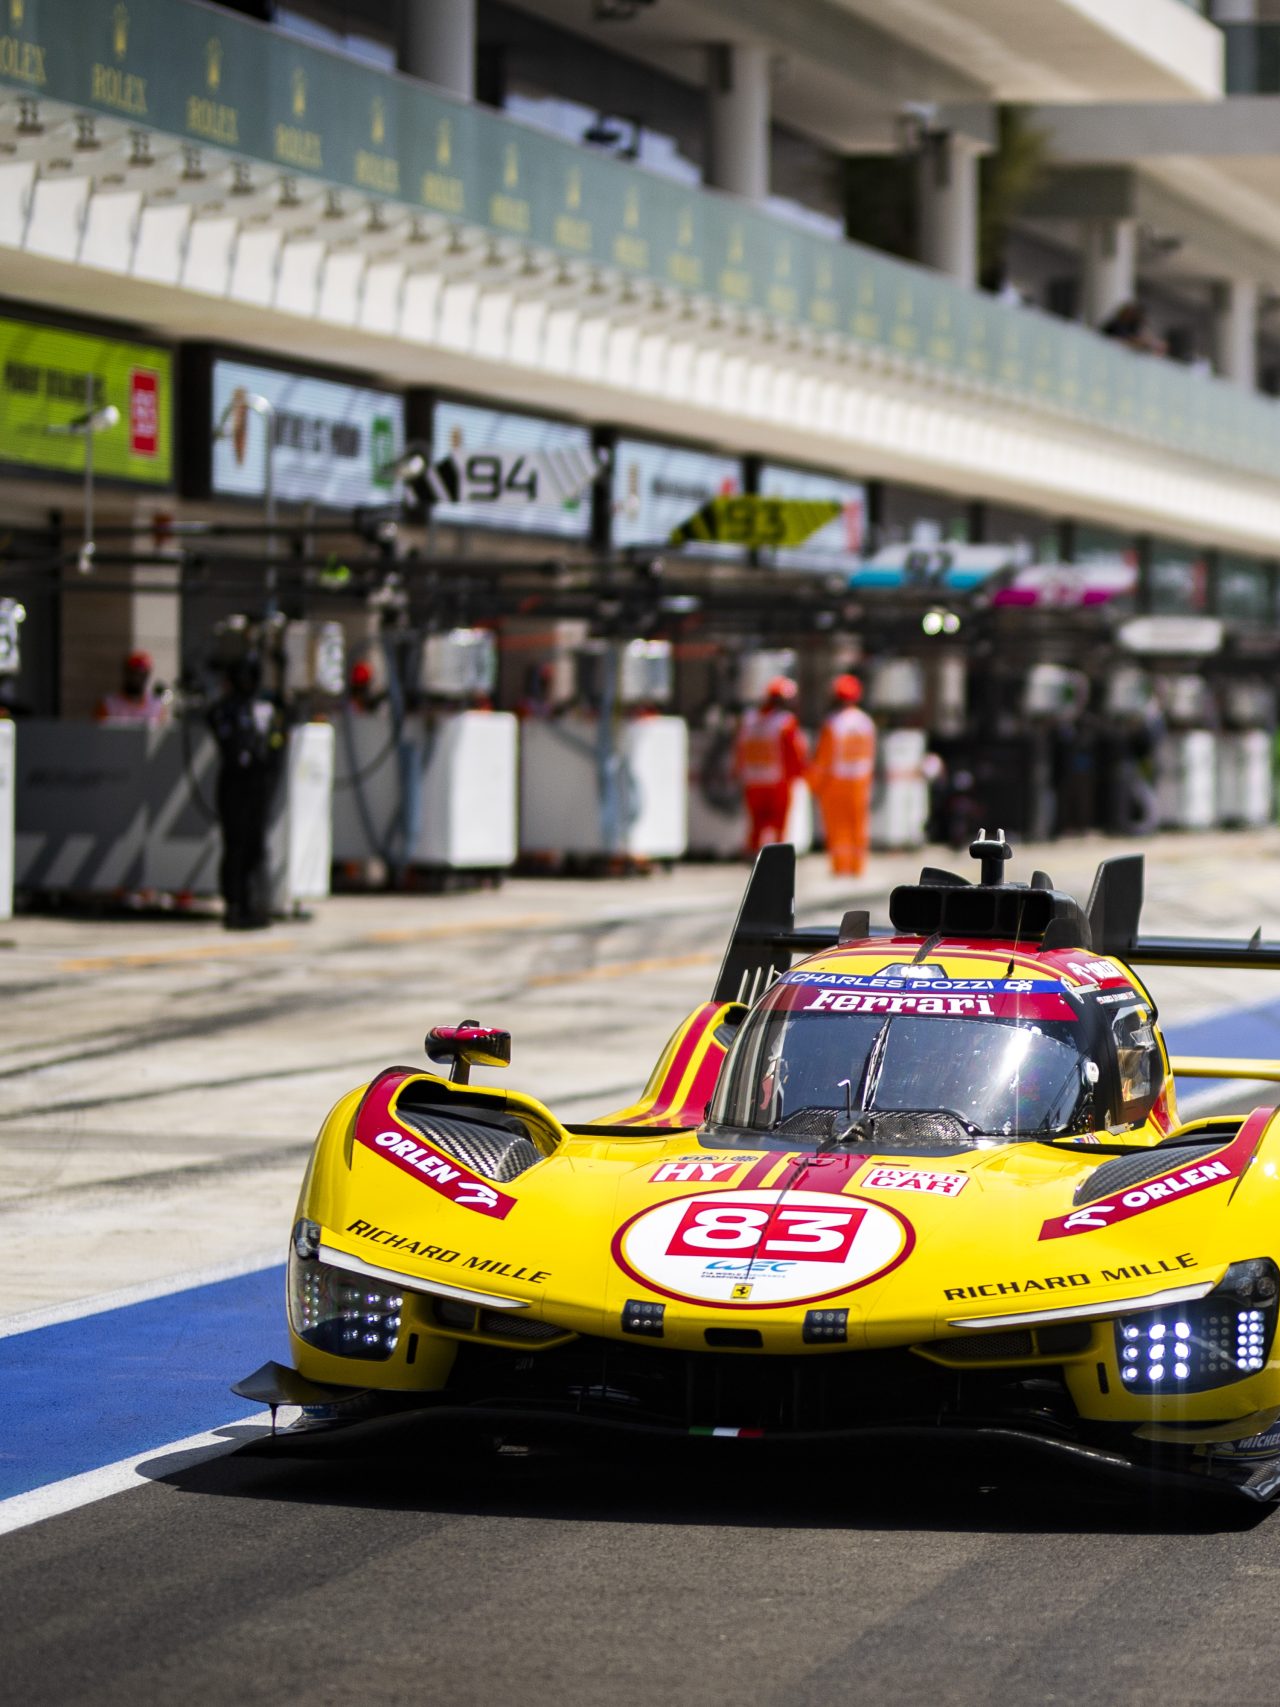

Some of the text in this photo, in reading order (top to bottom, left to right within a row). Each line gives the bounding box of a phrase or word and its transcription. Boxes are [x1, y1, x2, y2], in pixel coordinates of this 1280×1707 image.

[0, 34, 46, 87] OLEX
[92, 62, 148, 116] ROLEX
[187, 95, 239, 146] ROLEX
[467, 454, 538, 502] 94
[790, 973, 907, 989] CHARLES
[912, 980, 994, 990] POZZI
[803, 988, 995, 1016] Ferrari
[375, 1131, 461, 1184] ORLEN
[652, 1163, 737, 1181] HY
[877, 1170, 960, 1183] HYPER
[870, 1176, 955, 1193] CAR
[1122, 1161, 1231, 1208] ORLEN
[346, 1219, 552, 1284] RICHARD MILLE
[682, 1207, 853, 1253] 83
[944, 1252, 1198, 1301] RICHARD MILLE
